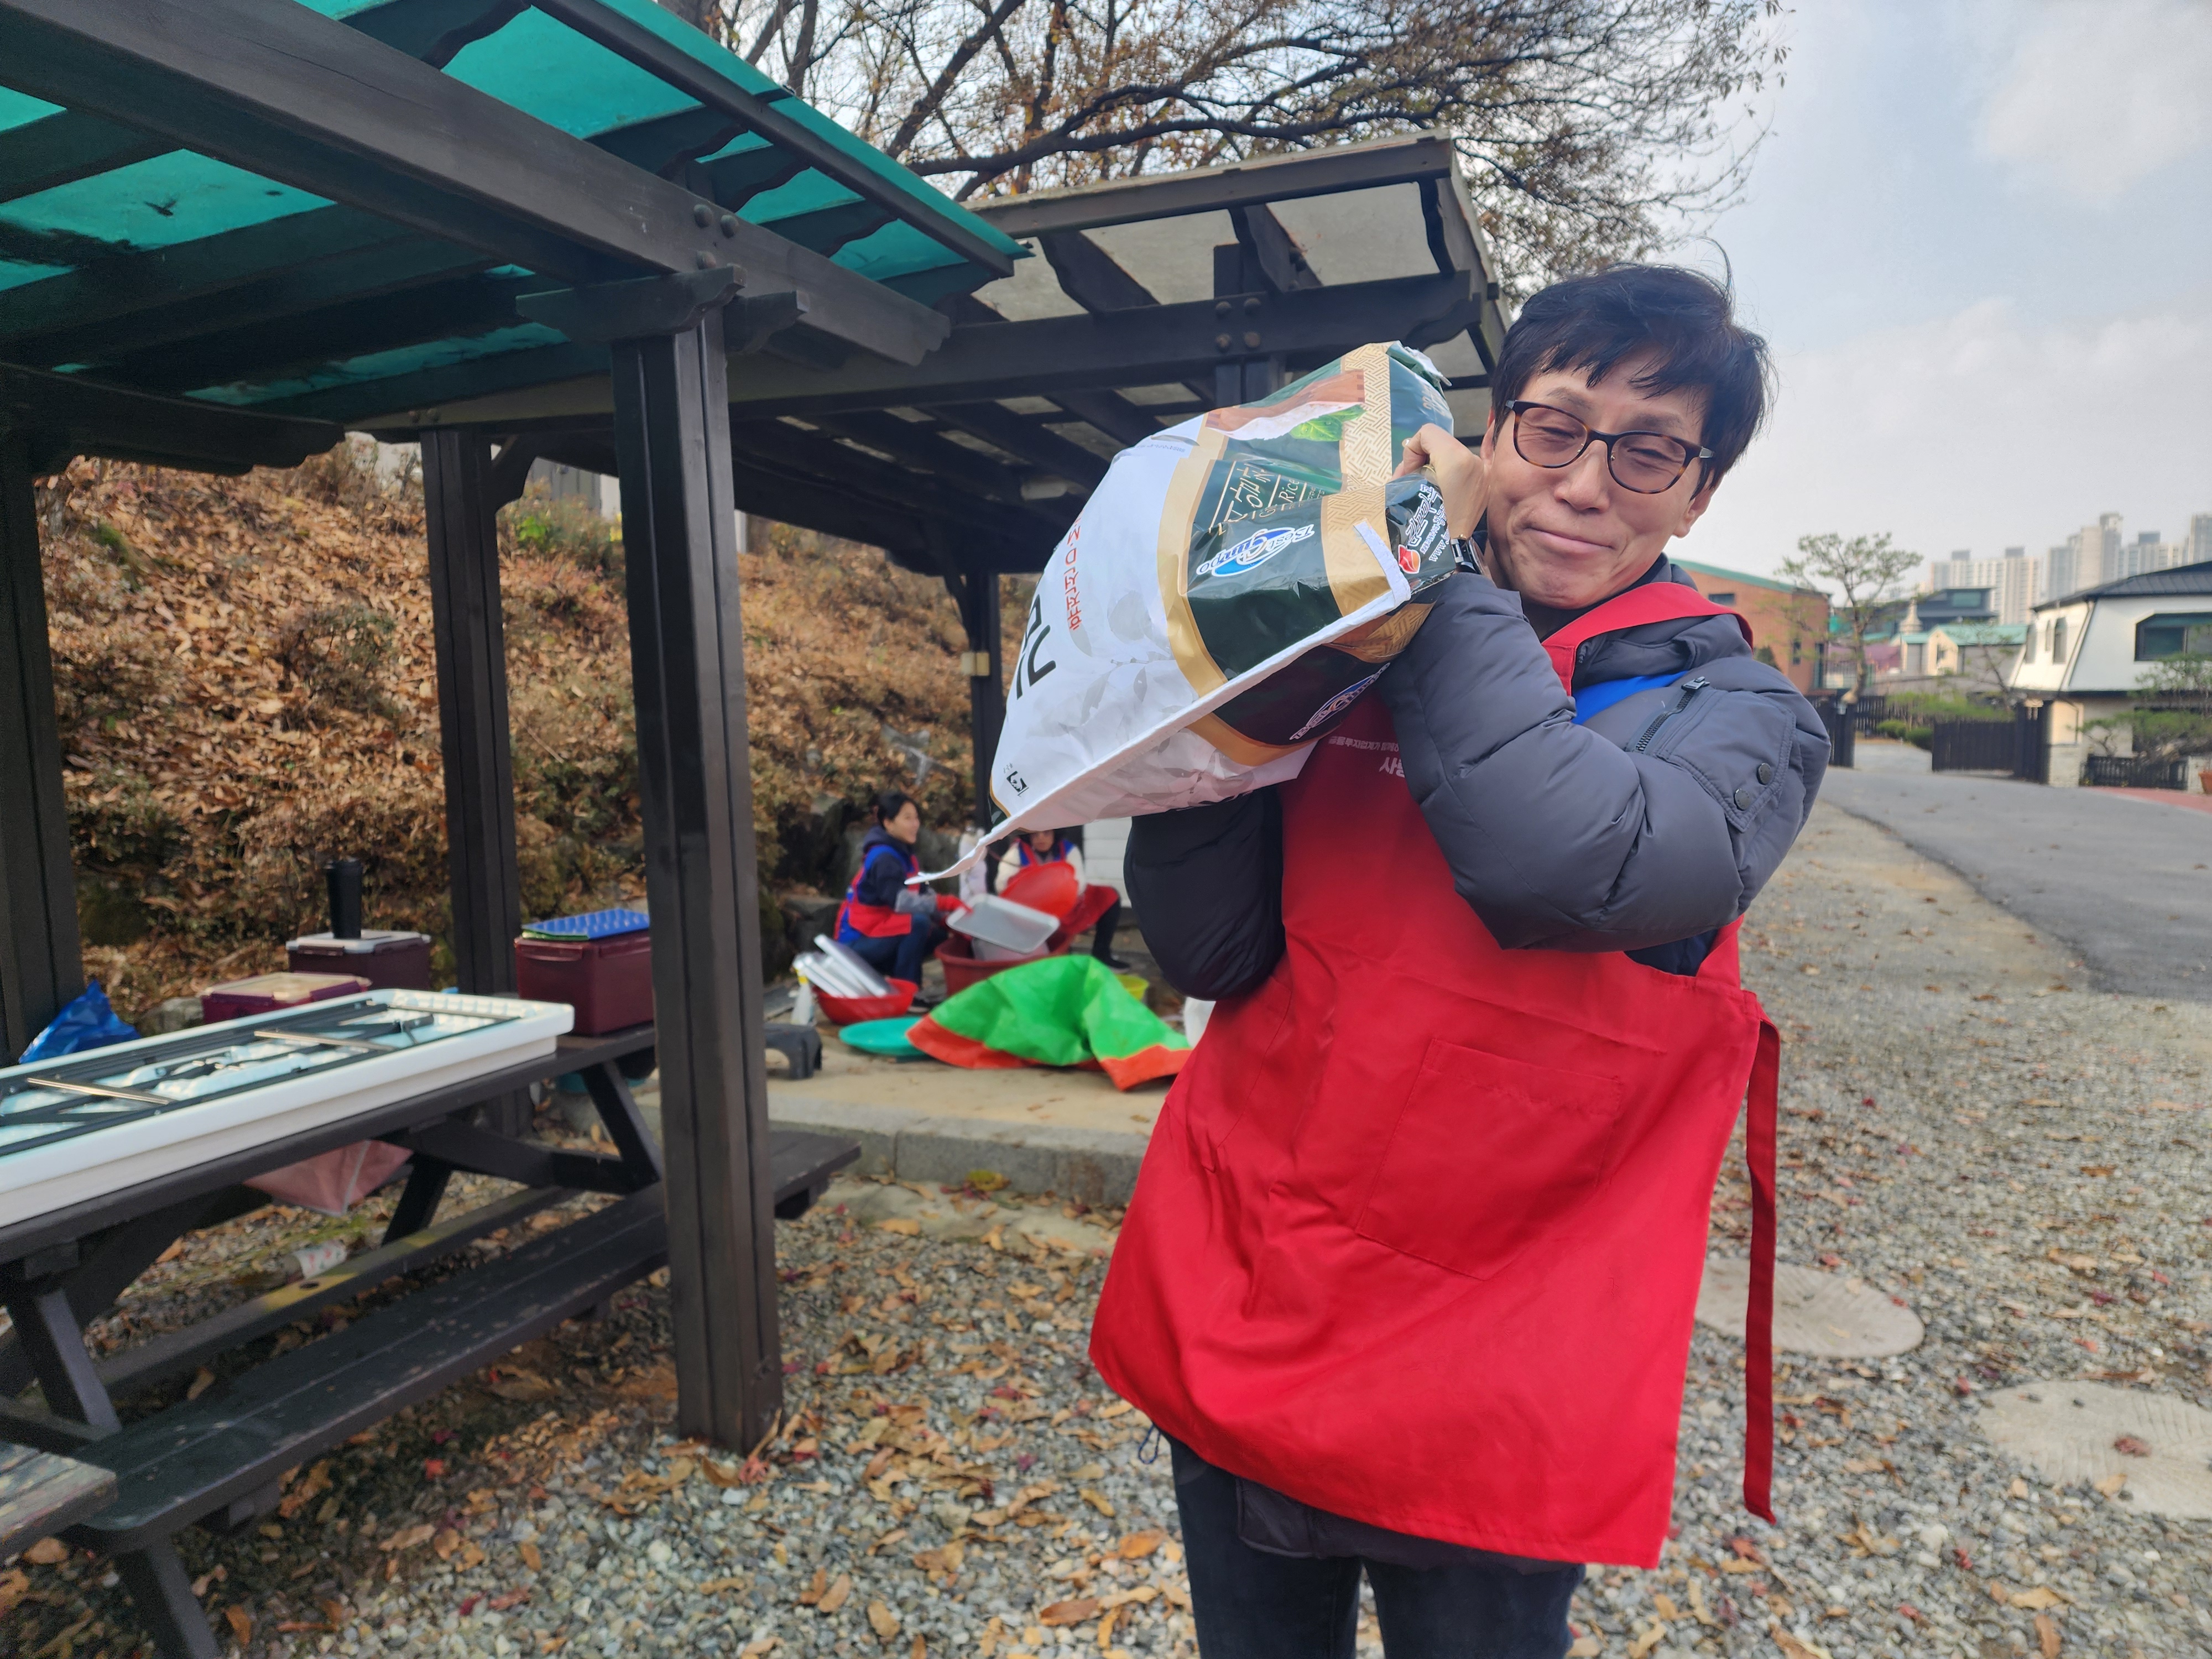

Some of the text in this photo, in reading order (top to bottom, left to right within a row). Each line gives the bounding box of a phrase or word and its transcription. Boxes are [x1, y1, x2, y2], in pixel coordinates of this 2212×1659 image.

[1279, 479, 1300, 503] Rice
[1197, 524, 1314, 575] Best Gimpo
[1063, 566, 1082, 630] 휴전선
[1290, 709, 1328, 740] Best
